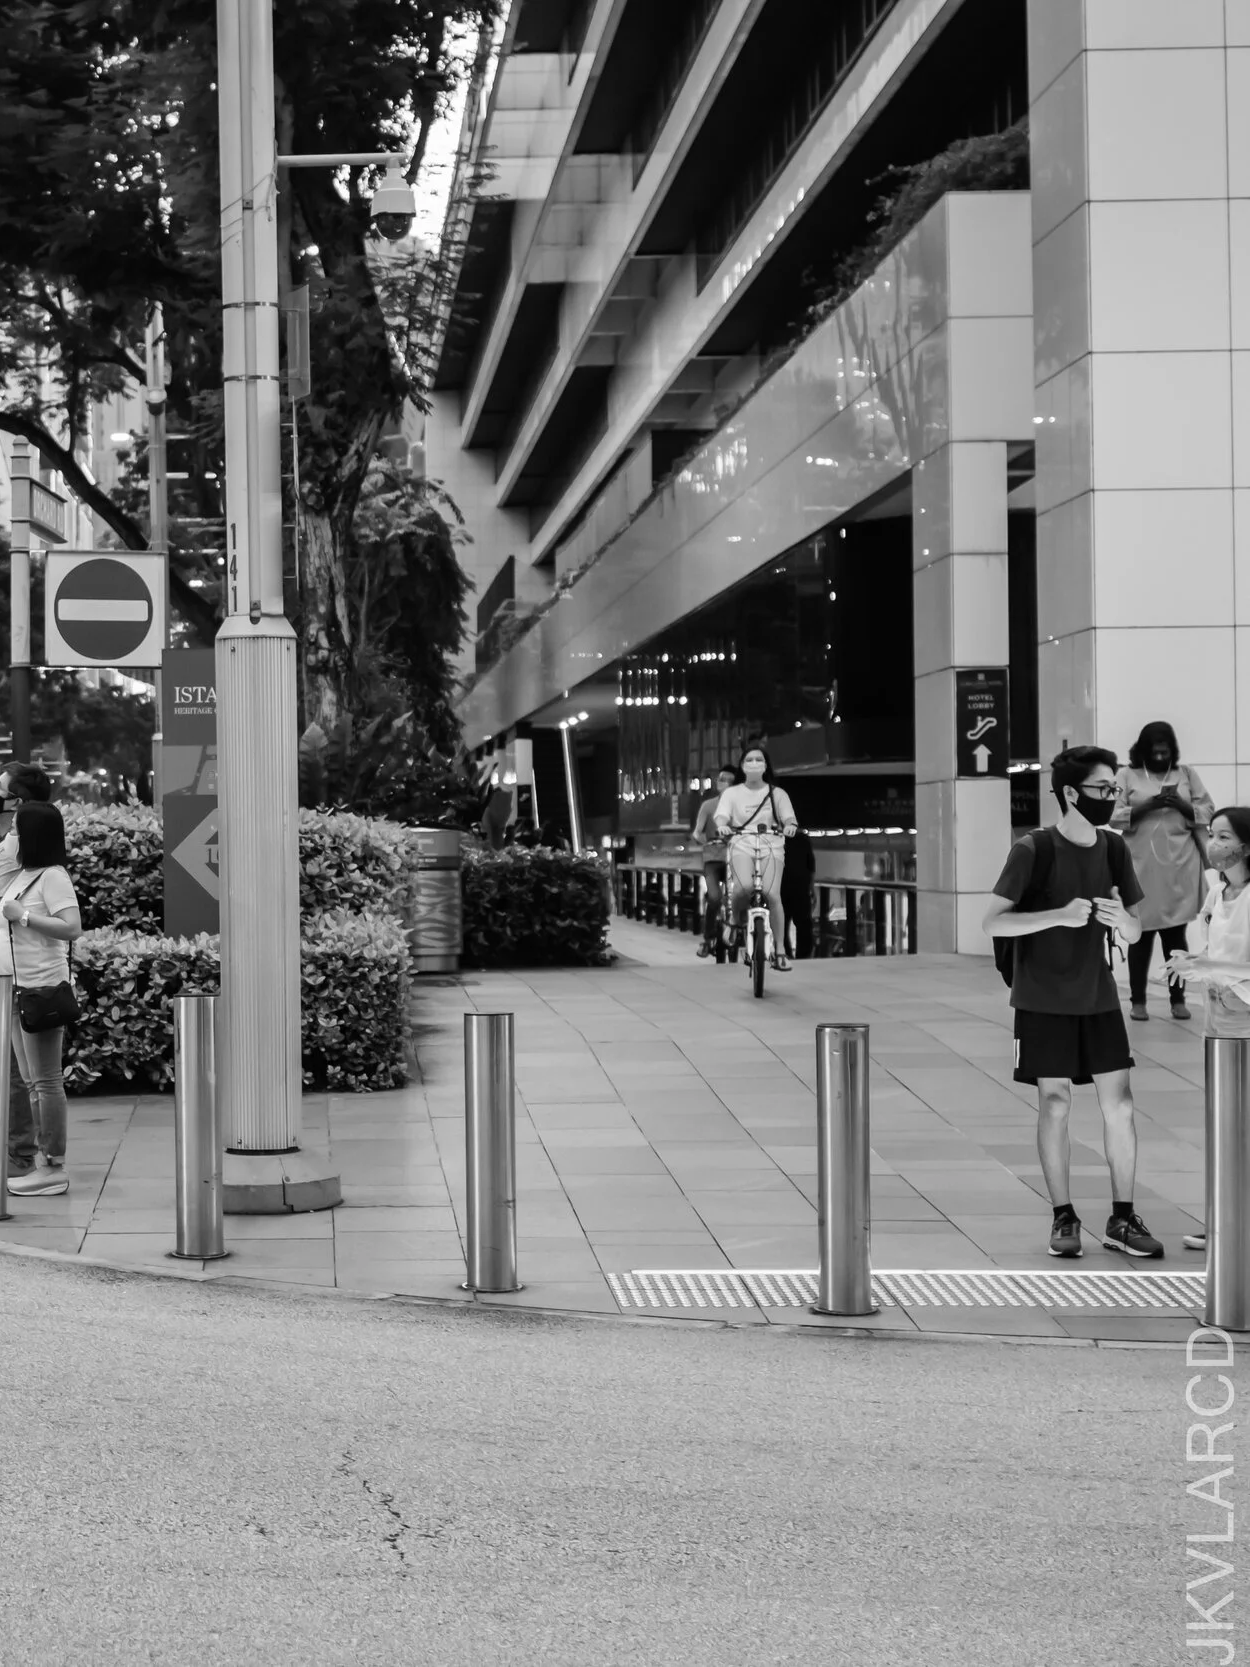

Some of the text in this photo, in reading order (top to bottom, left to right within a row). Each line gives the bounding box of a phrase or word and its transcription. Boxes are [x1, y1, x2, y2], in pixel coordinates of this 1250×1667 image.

[968, 694, 994, 702] HOTEL
[967, 702, 995, 710] LOBBY
[174, 707, 213, 715] HERITAGE
